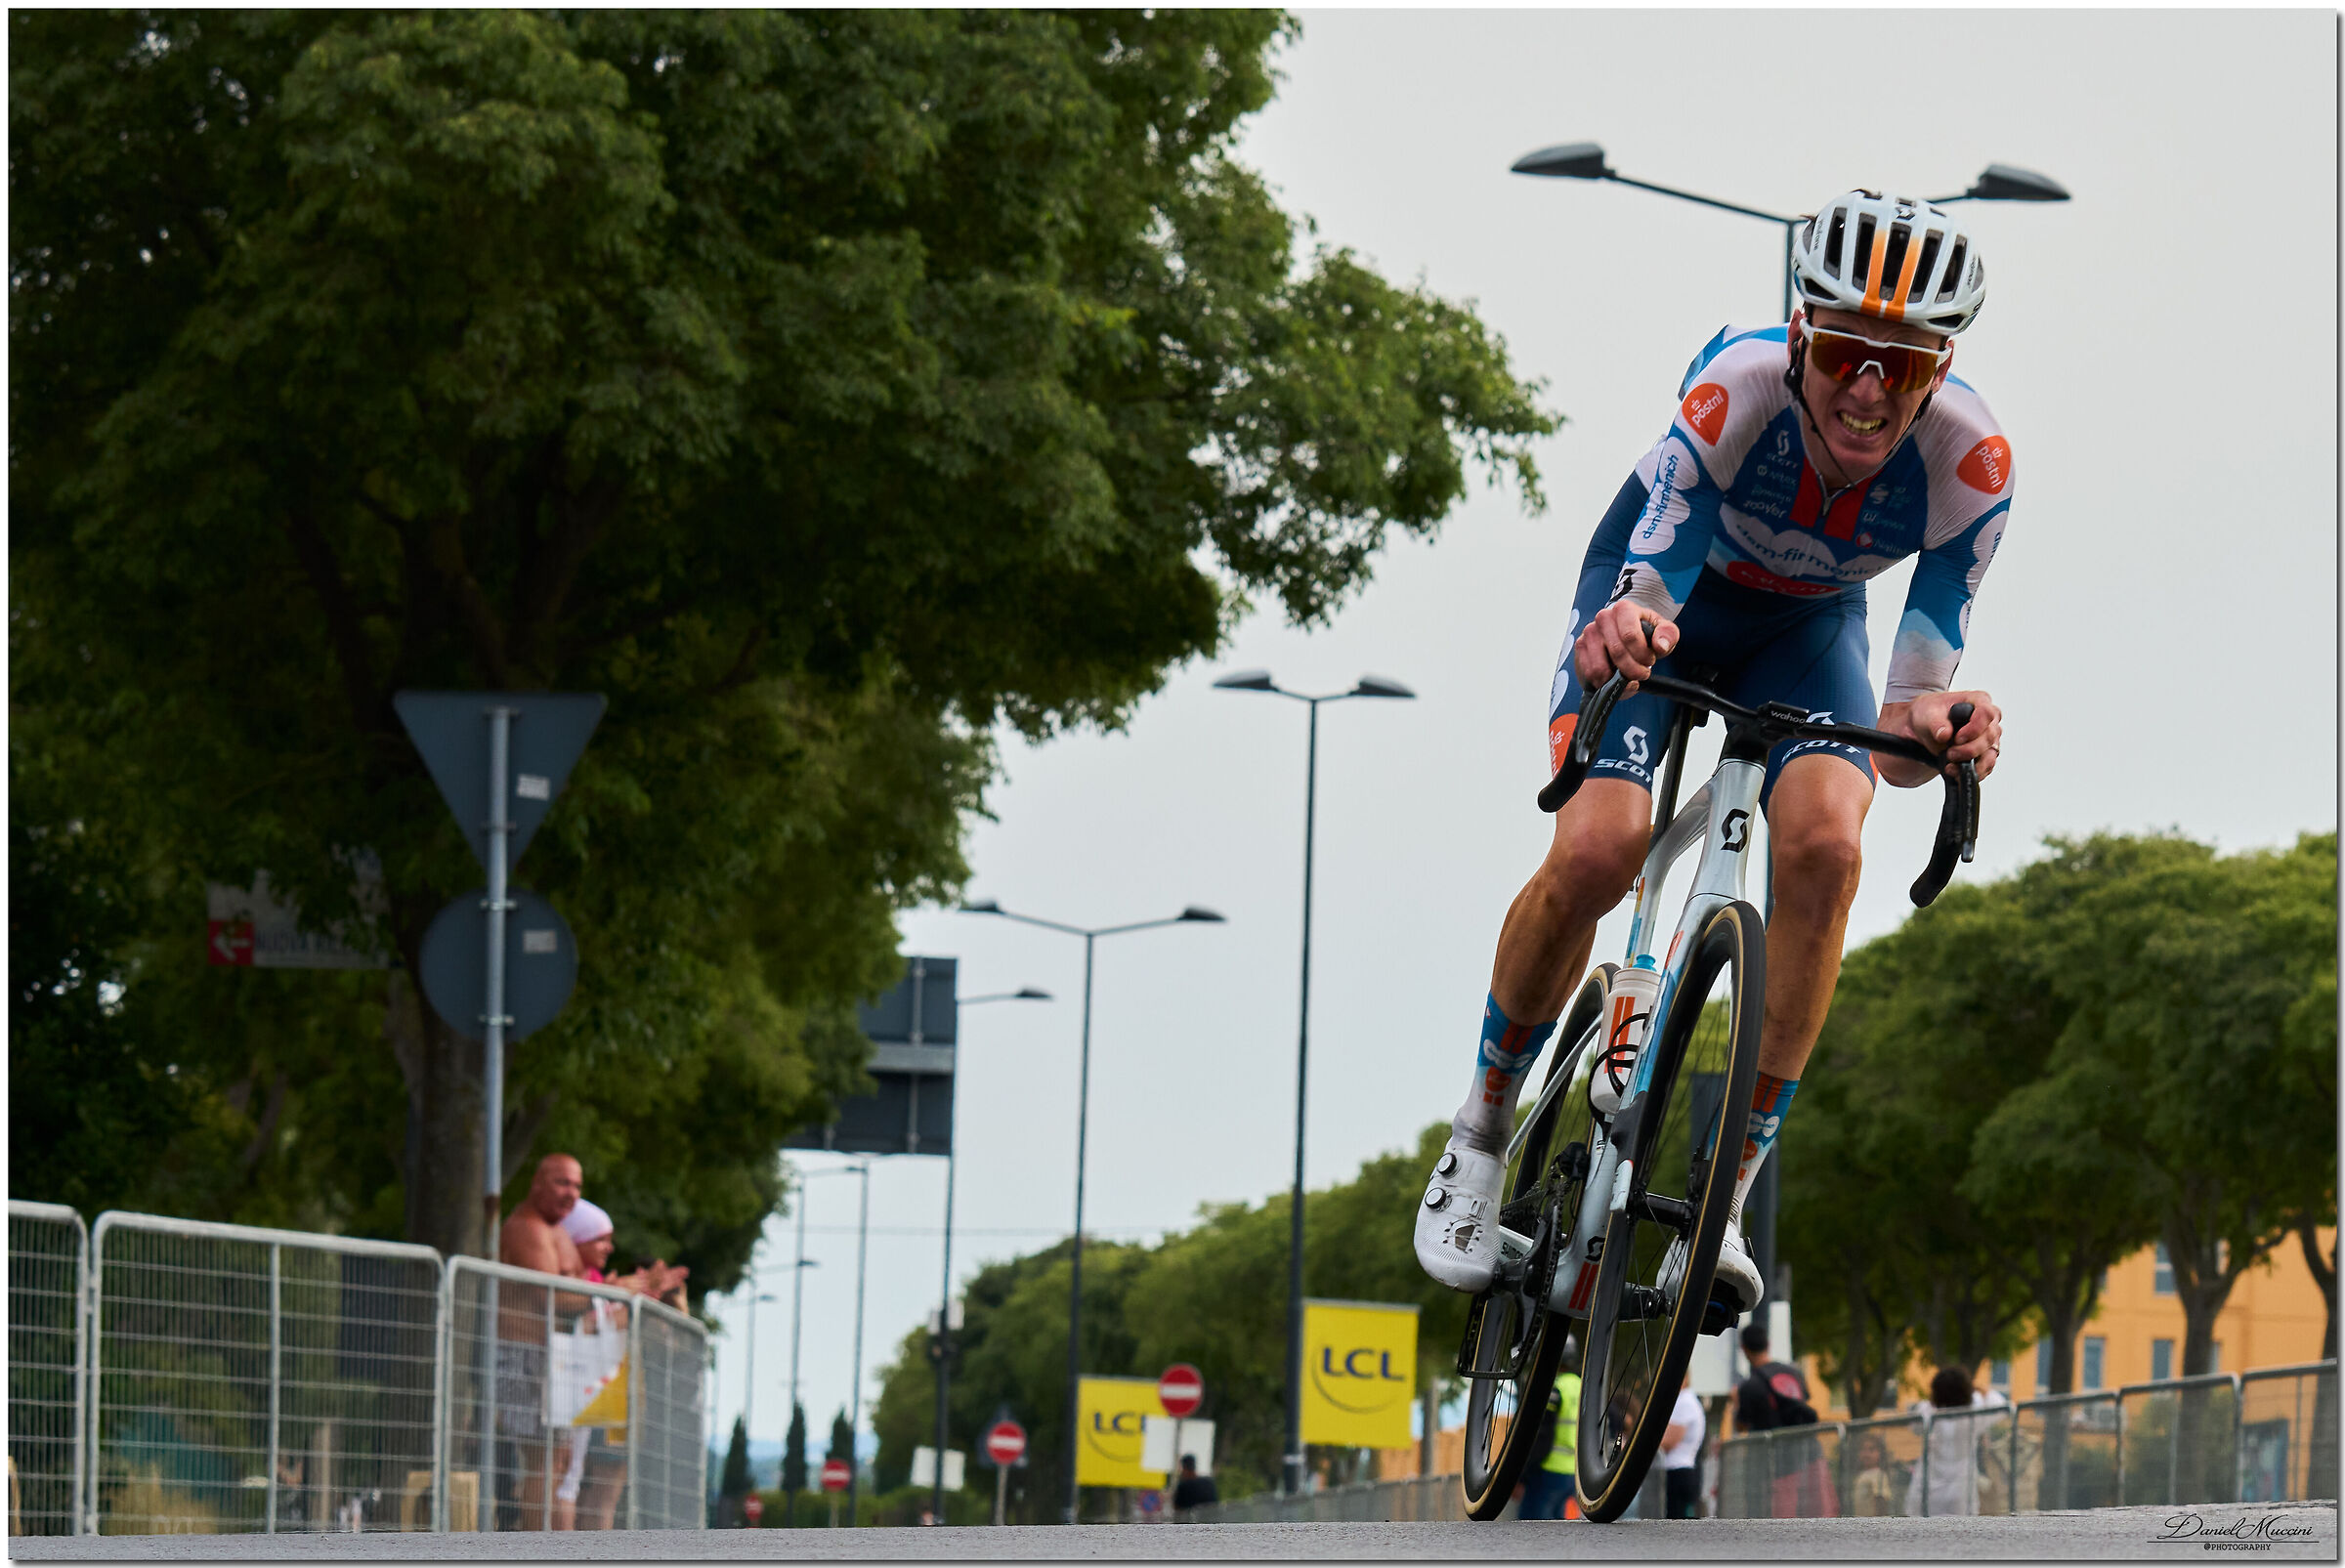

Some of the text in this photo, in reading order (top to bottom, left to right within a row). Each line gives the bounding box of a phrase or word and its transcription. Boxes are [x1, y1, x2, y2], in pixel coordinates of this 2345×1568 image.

[1691, 390, 1725, 428] postnl
[1976, 445, 2004, 488] postnl
[1642, 454, 1680, 539] dsm-firmenich
[1770, 710, 1806, 724] wahoo
[1323, 1346, 1406, 1381] LCL
